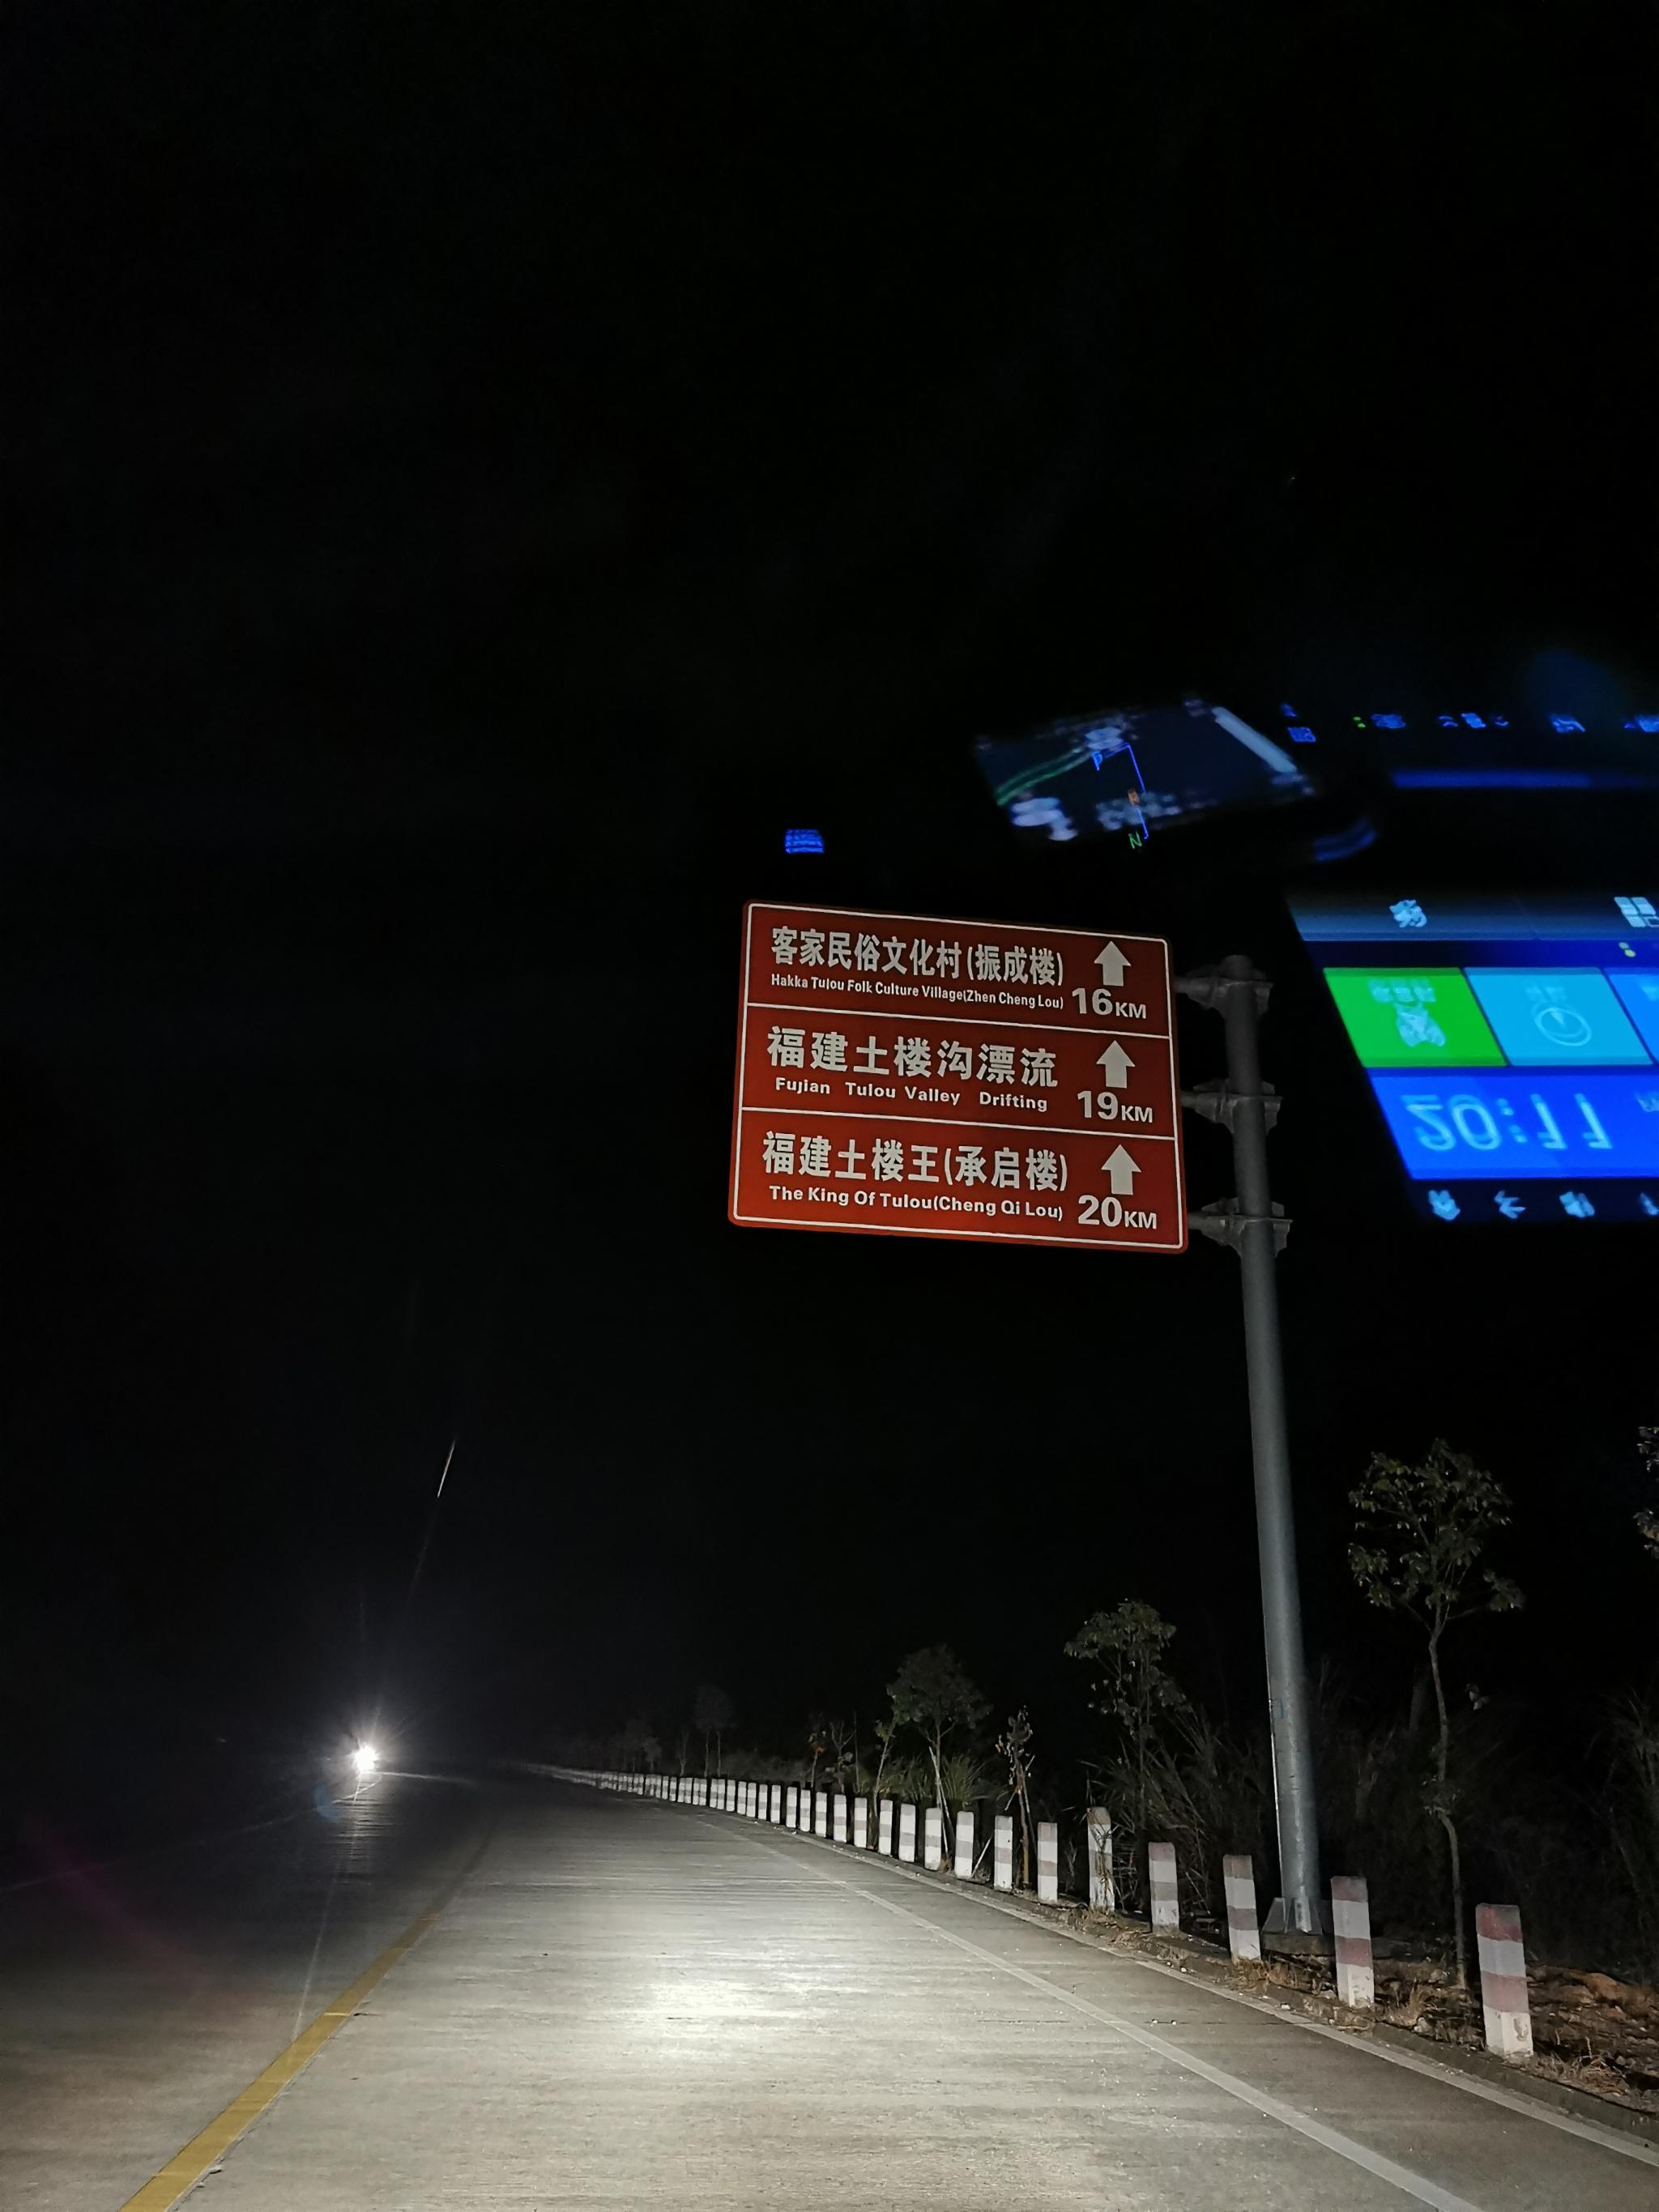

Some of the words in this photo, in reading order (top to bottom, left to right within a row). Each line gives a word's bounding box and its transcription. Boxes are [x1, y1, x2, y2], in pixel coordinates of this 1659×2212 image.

[771, 926, 1064, 987] 客家民俗文化村(振成楼)
[771, 974, 808, 988] Hakka
[811, 976, 844, 991] Tulou
[847, 980, 872, 994] Folk
[875, 982, 919, 997] Culture
[998, 991, 1036, 1009] Cheng
[1038, 995, 1064, 1010] Lou)
[1072, 987, 1147, 1020] 16KM
[766, 1025, 1059, 1088] 福建土楼沟漂流
[775, 1076, 830, 1094] Fujian
[845, 1081, 896, 1098] Tulou
[904, 1085, 961, 1106] Valley
[979, 1091, 1048, 1113] Drifting
[1077, 1090, 1154, 1123] 19KM
[762, 1130, 1068, 1192] 福建土楼王(承启楼)
[769, 1185, 804, 1200] The
[808, 1187, 850, 1207] King
[854, 1191, 876, 1206] Of
[880, 1193, 996, 1217] Tulou(Cheng
[1000, 1200, 1020, 1216] Qi
[1025, 1201, 1064, 1222] Lou)
[1077, 1195, 1158, 1230] 20KM
